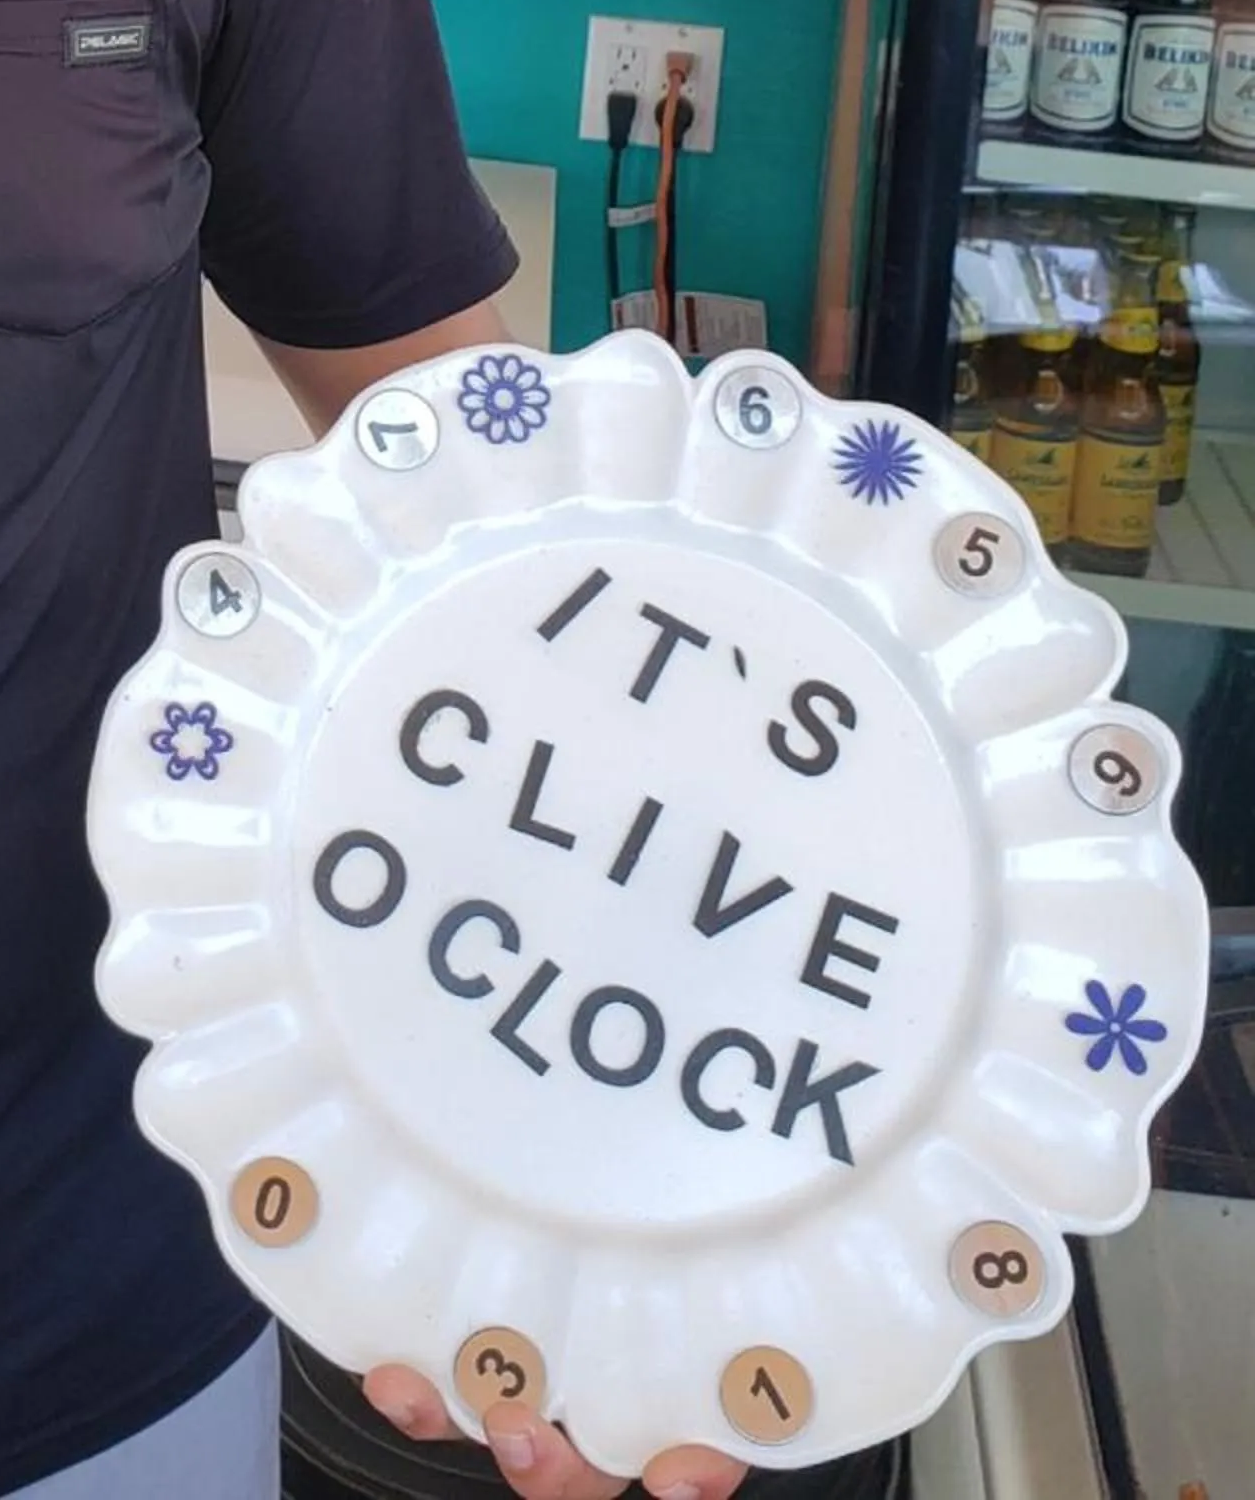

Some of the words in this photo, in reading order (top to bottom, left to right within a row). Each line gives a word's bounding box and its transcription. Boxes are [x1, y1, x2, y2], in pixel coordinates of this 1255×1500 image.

[738, 385, 773, 436] 6
[957, 526, 1001, 578] 5
[209, 567, 243, 617] 4
[398, 689, 900, 1010] CLIVE
[312, 829, 880, 1167] OCLOCK
[972, 1249, 1029, 1290] 8
[475, 1347, 527, 1399] 3
[749, 1366, 791, 1422] 1
